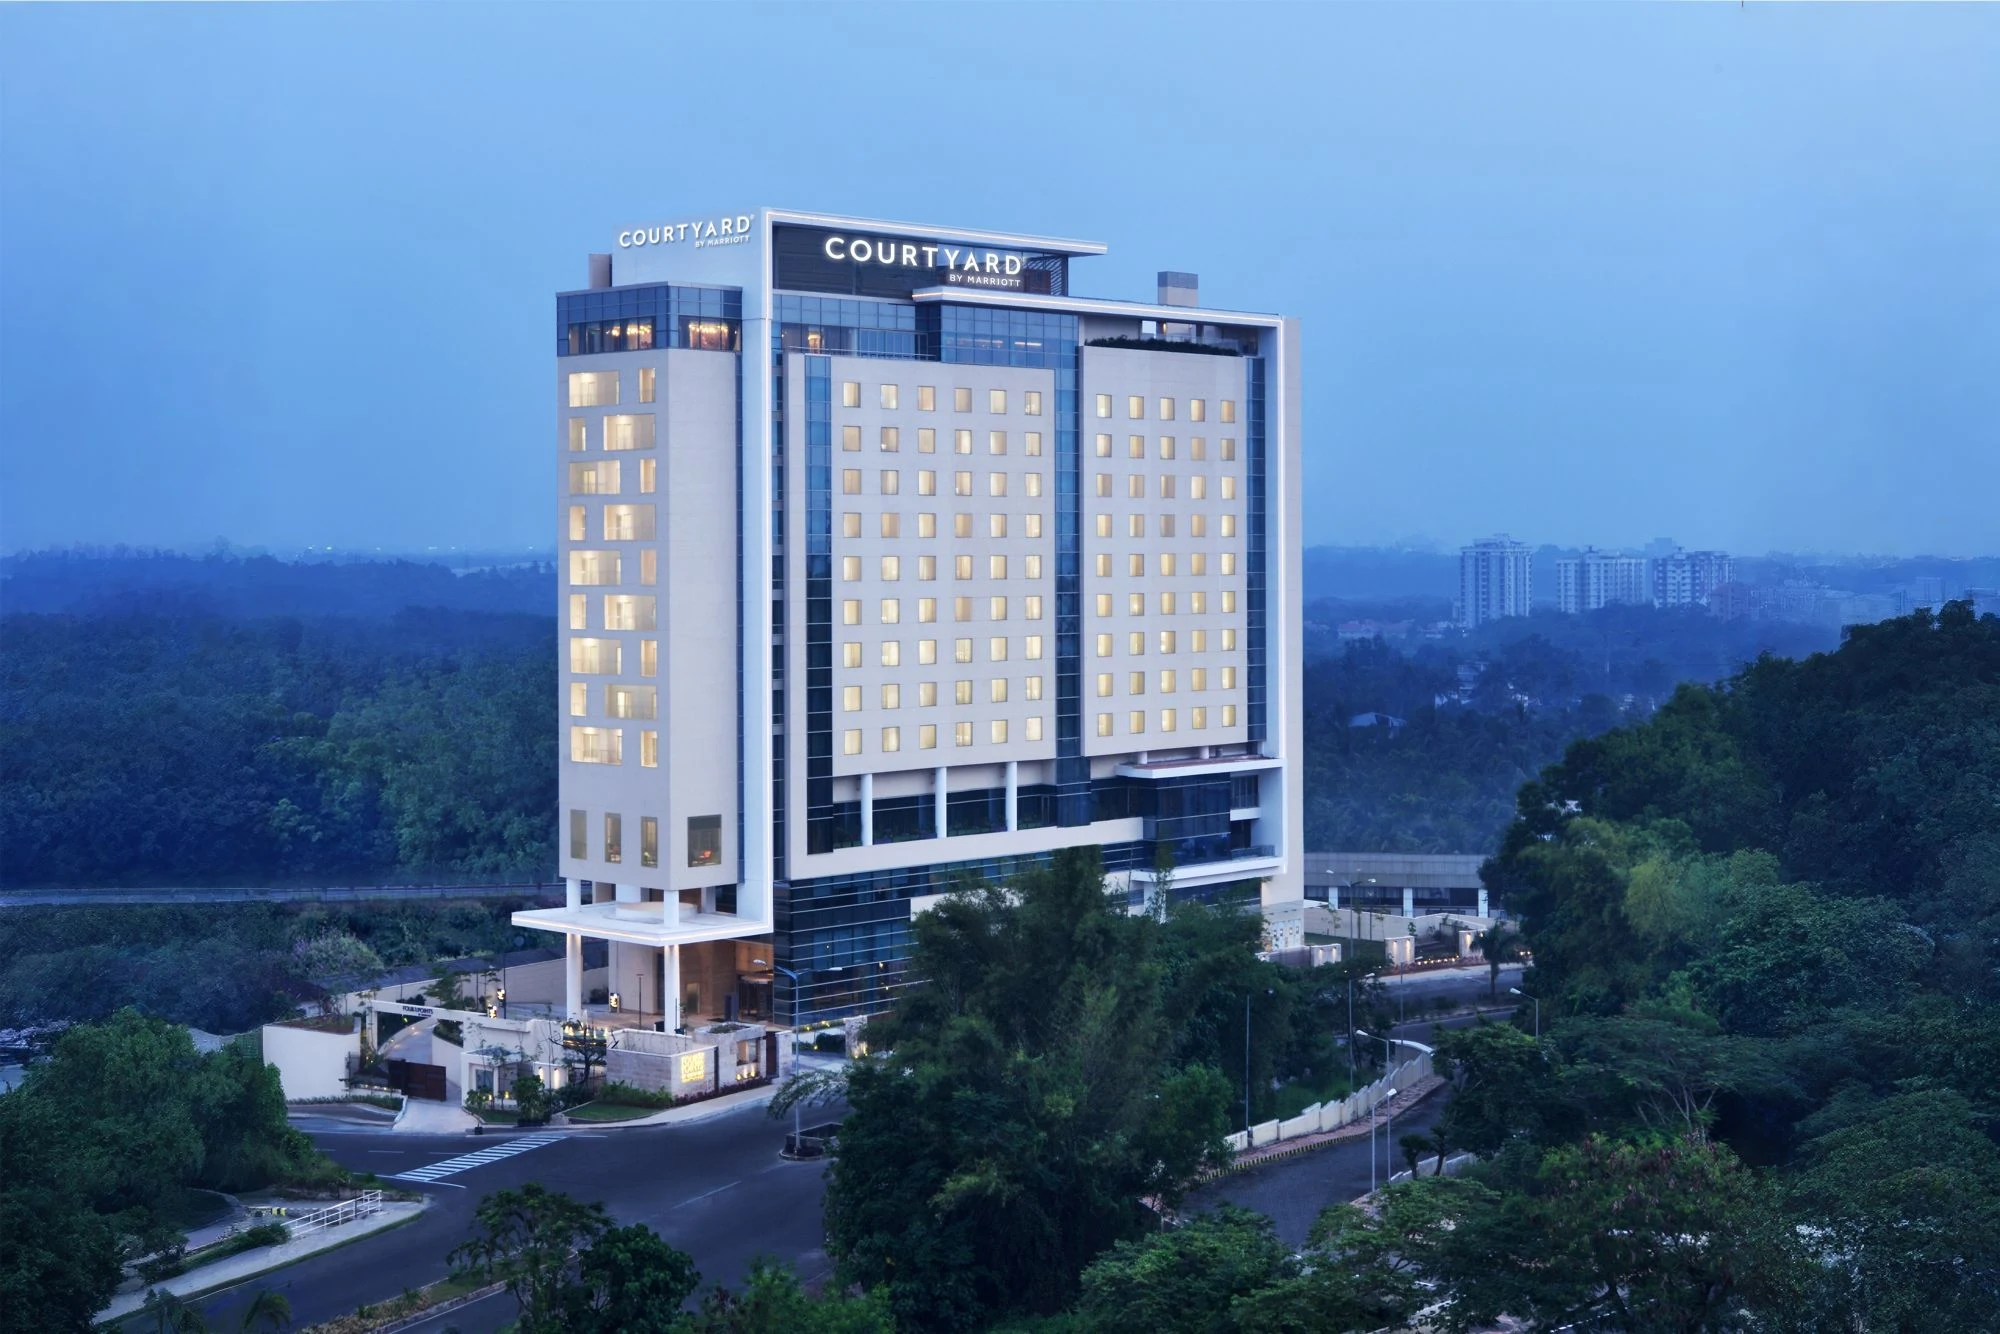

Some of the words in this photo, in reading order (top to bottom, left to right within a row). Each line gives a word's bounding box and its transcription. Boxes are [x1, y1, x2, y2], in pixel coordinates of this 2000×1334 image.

[619, 216, 750, 248] COURTYARD
[707, 235, 750, 246] MARRIOTT
[825, 237, 1021, 275] COURTYARD
[950, 274, 962, 282] BY
[967, 276, 1021, 287] MARRIOTT
